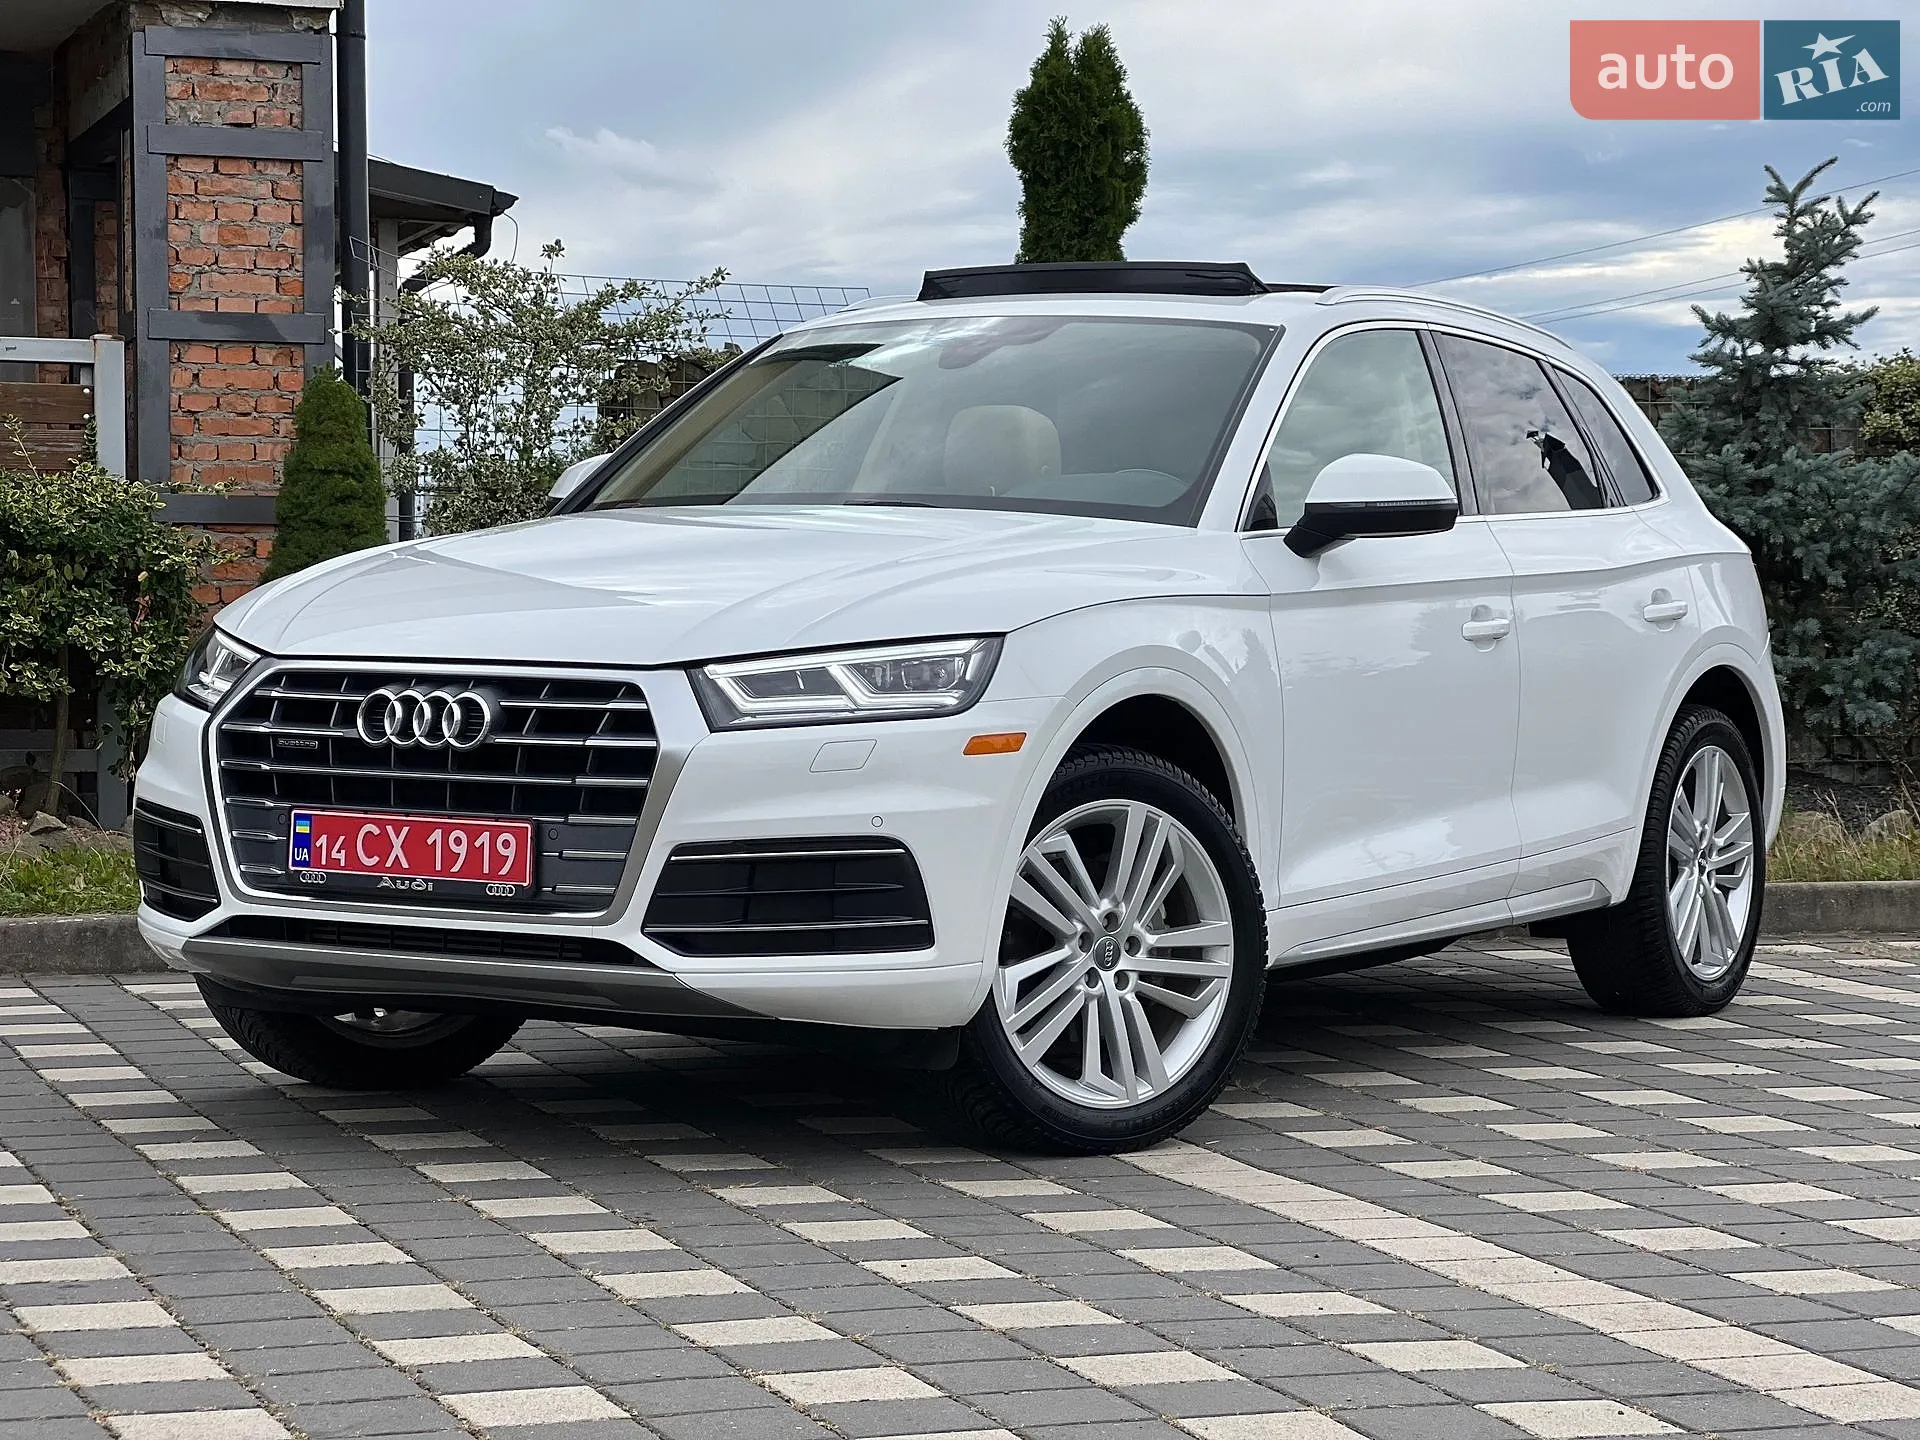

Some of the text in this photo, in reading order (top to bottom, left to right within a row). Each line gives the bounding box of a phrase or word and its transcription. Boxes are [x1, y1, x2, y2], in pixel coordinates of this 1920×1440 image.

[294, 847, 309, 861] UA
[315, 823, 517, 876] 14 CX 1919
[376, 876, 433, 892] Audi
